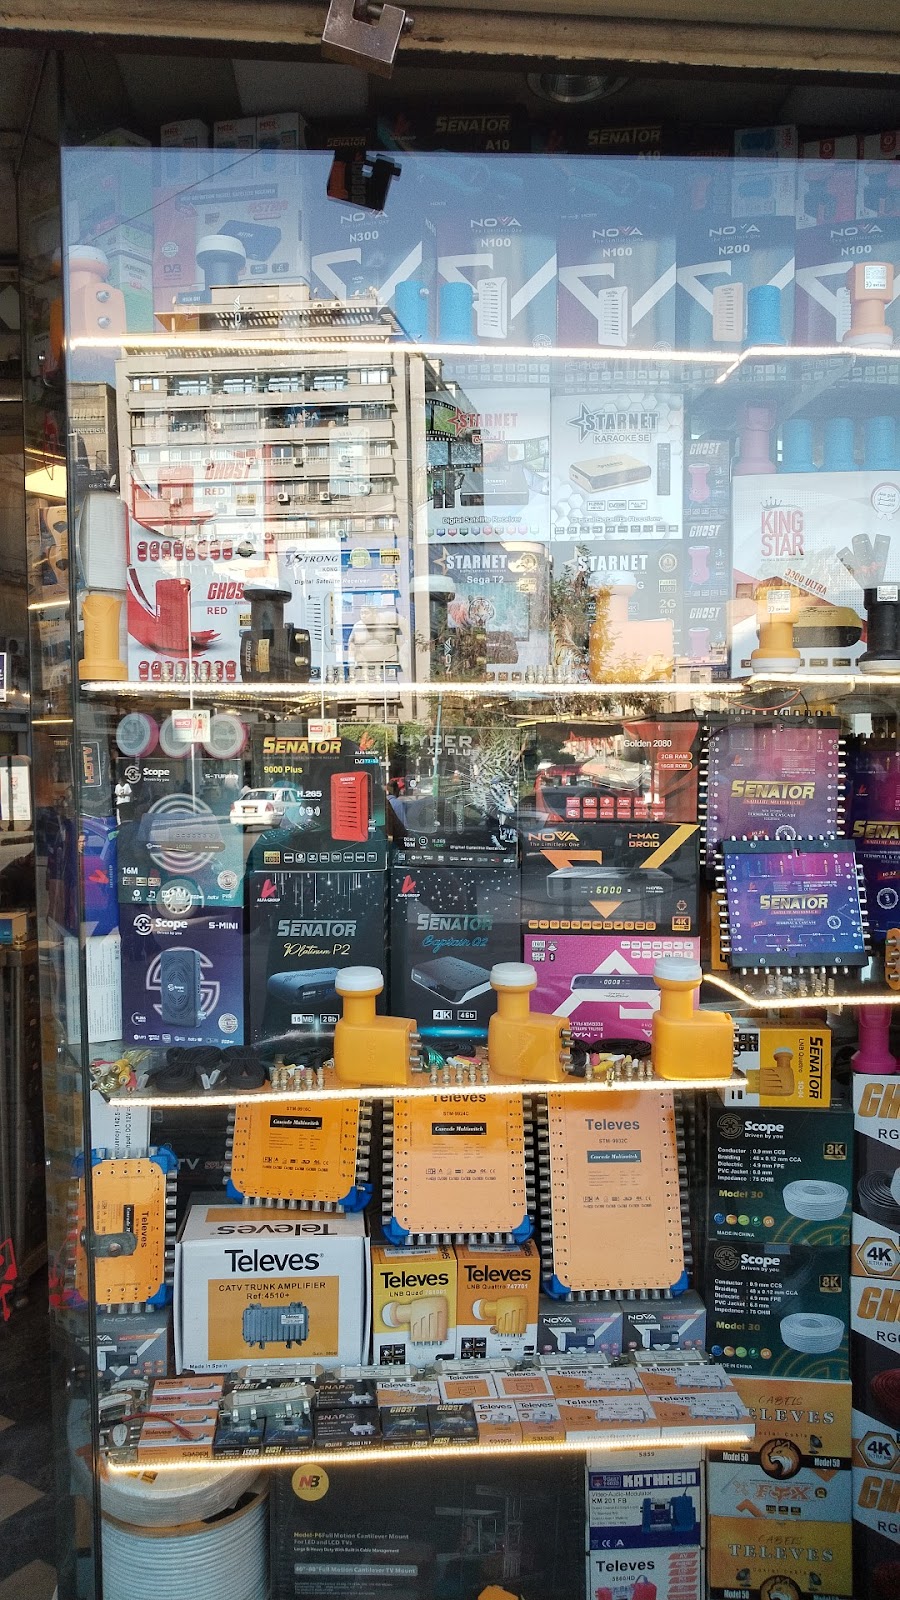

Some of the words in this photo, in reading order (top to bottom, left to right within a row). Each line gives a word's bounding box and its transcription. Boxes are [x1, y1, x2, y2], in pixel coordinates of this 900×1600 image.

[435, 115, 511, 133] SENATOR
[588, 126, 662, 145] SENATOR
[327, 137, 367, 147] SENATOR
[485, 140, 510, 150] A10
[340, 210, 388, 225] NOVA
[470, 217, 522, 228] NOVA
[592, 226, 643, 237] NOVA
[709, 223, 761, 236] NOVA
[830, 224, 884, 238] NOVA
[349, 230, 379, 243] N300
[481, 238, 511, 247] N100
[602, 247, 633, 257] N100
[718, 244, 750, 255] N200
[841, 245, 872, 256] N100
[460, 413, 518, 428] STARNET
[584, 413, 659, 432] STARNET
[593, 434, 638, 443] KARAOKE
[639, 434, 651, 442] SE
[690, 442, 722, 455] GHOST
[204, 487, 225, 496] RED
[491, 515, 523, 524] Receiver
[761, 511, 804, 534] KING
[690, 524, 721, 537] GHOST
[761, 534, 805, 556] STAR
[295, 553, 339, 563] STRONG
[446, 554, 508, 569] STARNET
[579, 554, 649, 571] STARNET
[467, 575, 491, 586] Sega
[493, 575, 504, 584] T2
[784, 567, 806, 585] 3300
[804, 578, 829, 596] ULTRA
[659, 600, 677, 609] 2G
[207, 607, 228, 615] RED
[690, 607, 722, 620] GHOST
[262, 737, 342, 755] SENATOR
[400, 734, 473, 748] HYPER
[623, 739, 651, 749] Golden
[653, 739, 672, 749] 2080
[447, 748, 477, 756] PLUS
[83, 745, 94, 784] HDTV
[264, 766, 283, 774] 9000
[285, 765, 303, 774] Plus
[143, 767, 170, 779] Scope
[297, 790, 323, 798] H.265
[730, 780, 816, 800] SENATOR
[528, 831, 580, 842] NOVA
[629, 832, 660, 840] I-MAC
[629, 840, 660, 848] DROID
[596, 886, 623, 894] 6000
[760, 893, 828, 910] SENATOR
[155, 918, 188, 930] Scope
[208, 921, 239, 930] S-MINI
[417, 913, 493, 931] SENATOR
[676, 917, 689, 925] 4K
[277, 919, 358, 937] SENATOR
[283, 943, 331, 957] Platinum
[333, 944, 351, 955] P2
[302, 1015, 315, 1024] MB
[434, 1010, 451, 1020] 4K
[808, 1036, 824, 1100] SENATOR
[585, 1119, 640, 1131] Televes
[744, 1121, 785, 1133] Scope
[826, 1144, 843, 1156] 8K
[719, 1189, 749, 1199] Model
[750, 1189, 764, 1199] 30
[140, 1210, 150, 1249] Televes
[217, 1223, 338, 1237] Televes
[866, 1246, 892, 1261] 4K
[224, 1248, 320, 1273] Televes
[740, 1253, 780, 1266] Scope
[380, 1270, 449, 1289] Televes
[464, 1265, 531, 1283] Televes
[219, 1284, 243, 1292] CATV
[244, 1283, 276, 1291] TRUNK
[277, 1281, 326, 1291] AMPLIFIER
[822, 1276, 839, 1287] 8K
[246, 1292, 290, 1300] Ref:4510+
[406, 1290, 424, 1298] Quad
[543, 1316, 572, 1324] NOVA
[628, 1313, 656, 1321] NOVA
[716, 1321, 746, 1331] Model
[748, 1321, 761, 1331] 30
[212, 1362, 228, 1370] Spain
[233, 1382, 260, 1390] GHOST
[436, 1404, 464, 1412] GHOST
[478, 1402, 513, 1410] Televes
[519, 1402, 554, 1410] Televes
[318, 1413, 345, 1421] SNAP
[866, 1441, 892, 1456] 4K
[723, 1451, 740, 1461] Model
[741, 1452, 749, 1462] 50
[814, 1458, 832, 1468] Model
[299, 1475, 321, 1488] NB
[622, 1471, 696, 1487] KATHREIN
[728, 1544, 834, 1563] TELEVES
[596, 1559, 655, 1573] Televes
[395, 1568, 416, 1576] Mount
[723, 1590, 741, 1599] Model
